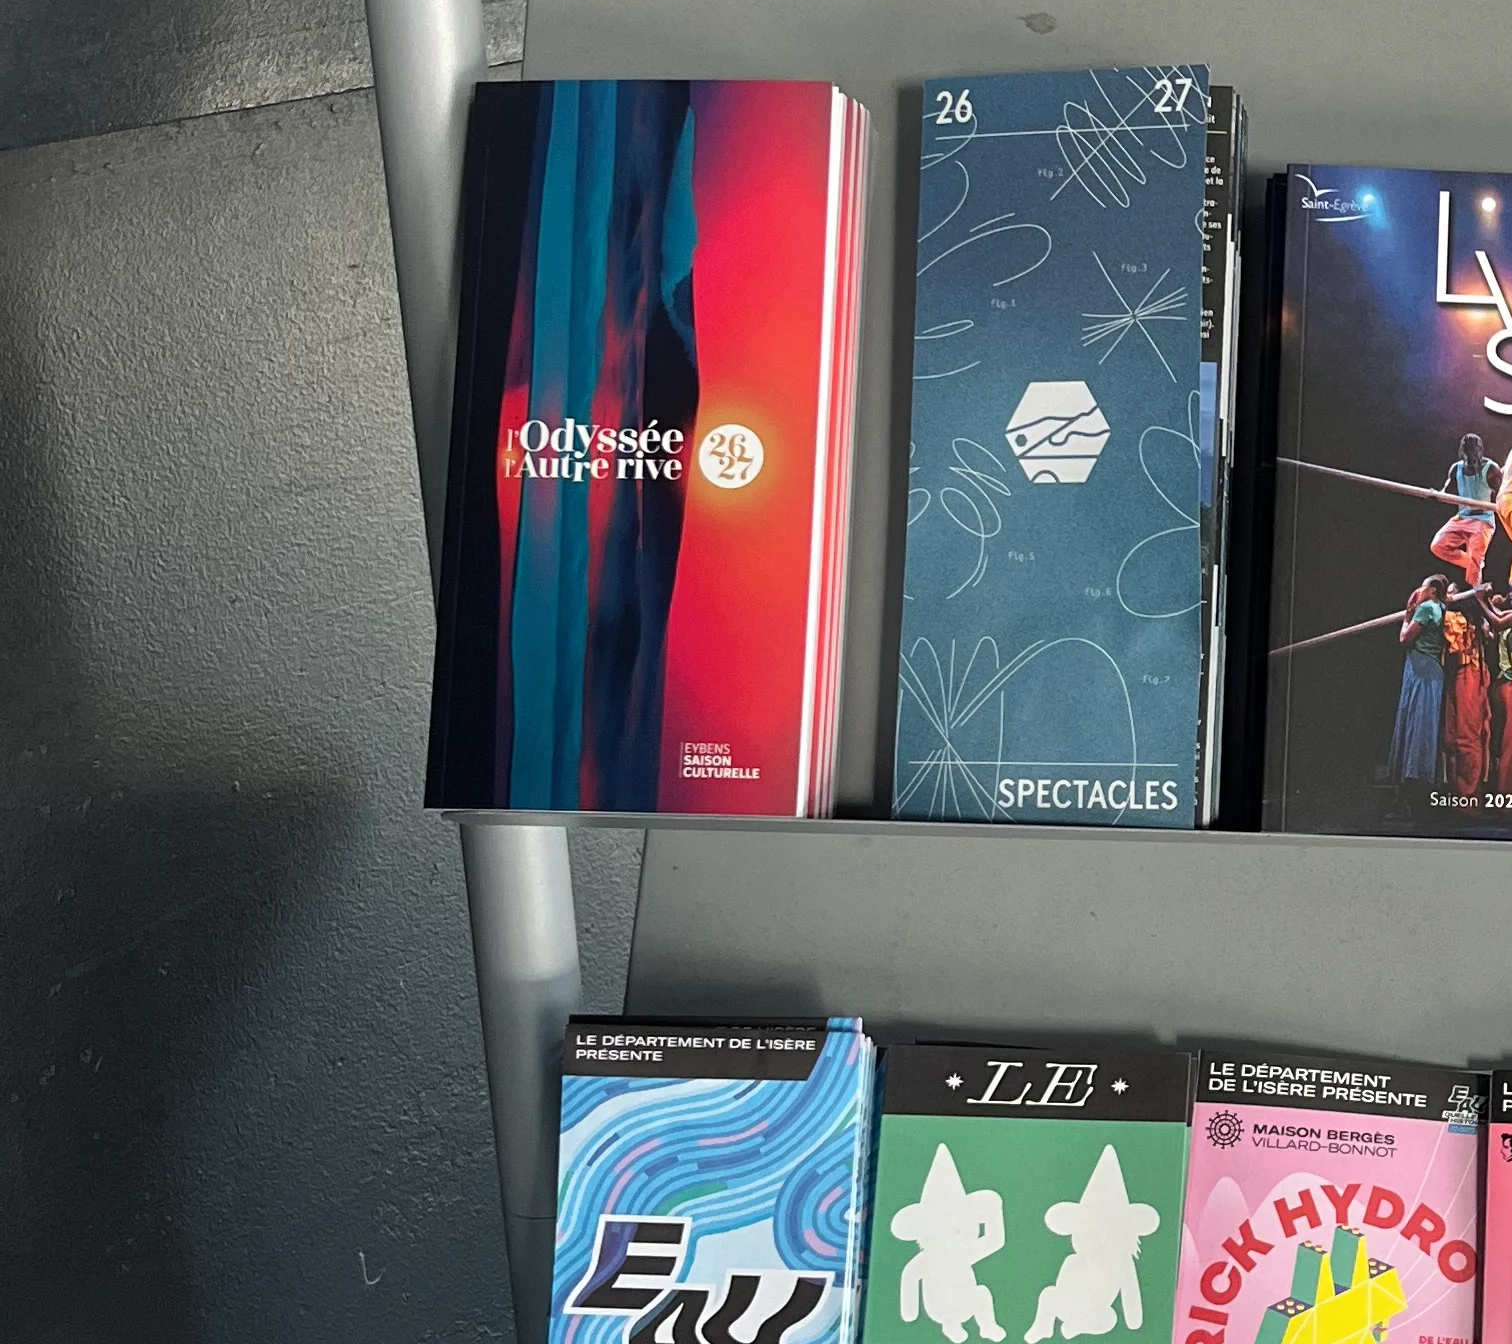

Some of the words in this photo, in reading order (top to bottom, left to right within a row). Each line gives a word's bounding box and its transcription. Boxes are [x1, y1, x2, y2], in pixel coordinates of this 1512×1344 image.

[935, 89, 973, 124] 26
[1154, 78, 1192, 114] 27
[616, 452, 682, 480] rive
[684, 743, 730, 755] EYBENS
[684, 756, 731, 766] SAISON
[683, 768, 760, 779] CULTURELLE
[998, 779, 1178, 811] SPECTACLES
[1430, 792, 1478, 808] Saison
[576, 1035, 597, 1046] LE
[603, 1034, 725, 1049] DÉPARTEMENT
[729, 1038, 752, 1049] DE
[757, 1037, 816, 1051] L'ISÈRE
[576, 1048, 663, 1061] PRÉSENTE
[967, 1060, 1098, 1107] LE
[1254, 1124, 1321, 1138] MAISON
[1327, 1128, 1395, 1145] BERGÈS
[1252, 1137, 1397, 1158] VILLARD-BONNOT
[1273, 1183, 1477, 1284] HYDRO
